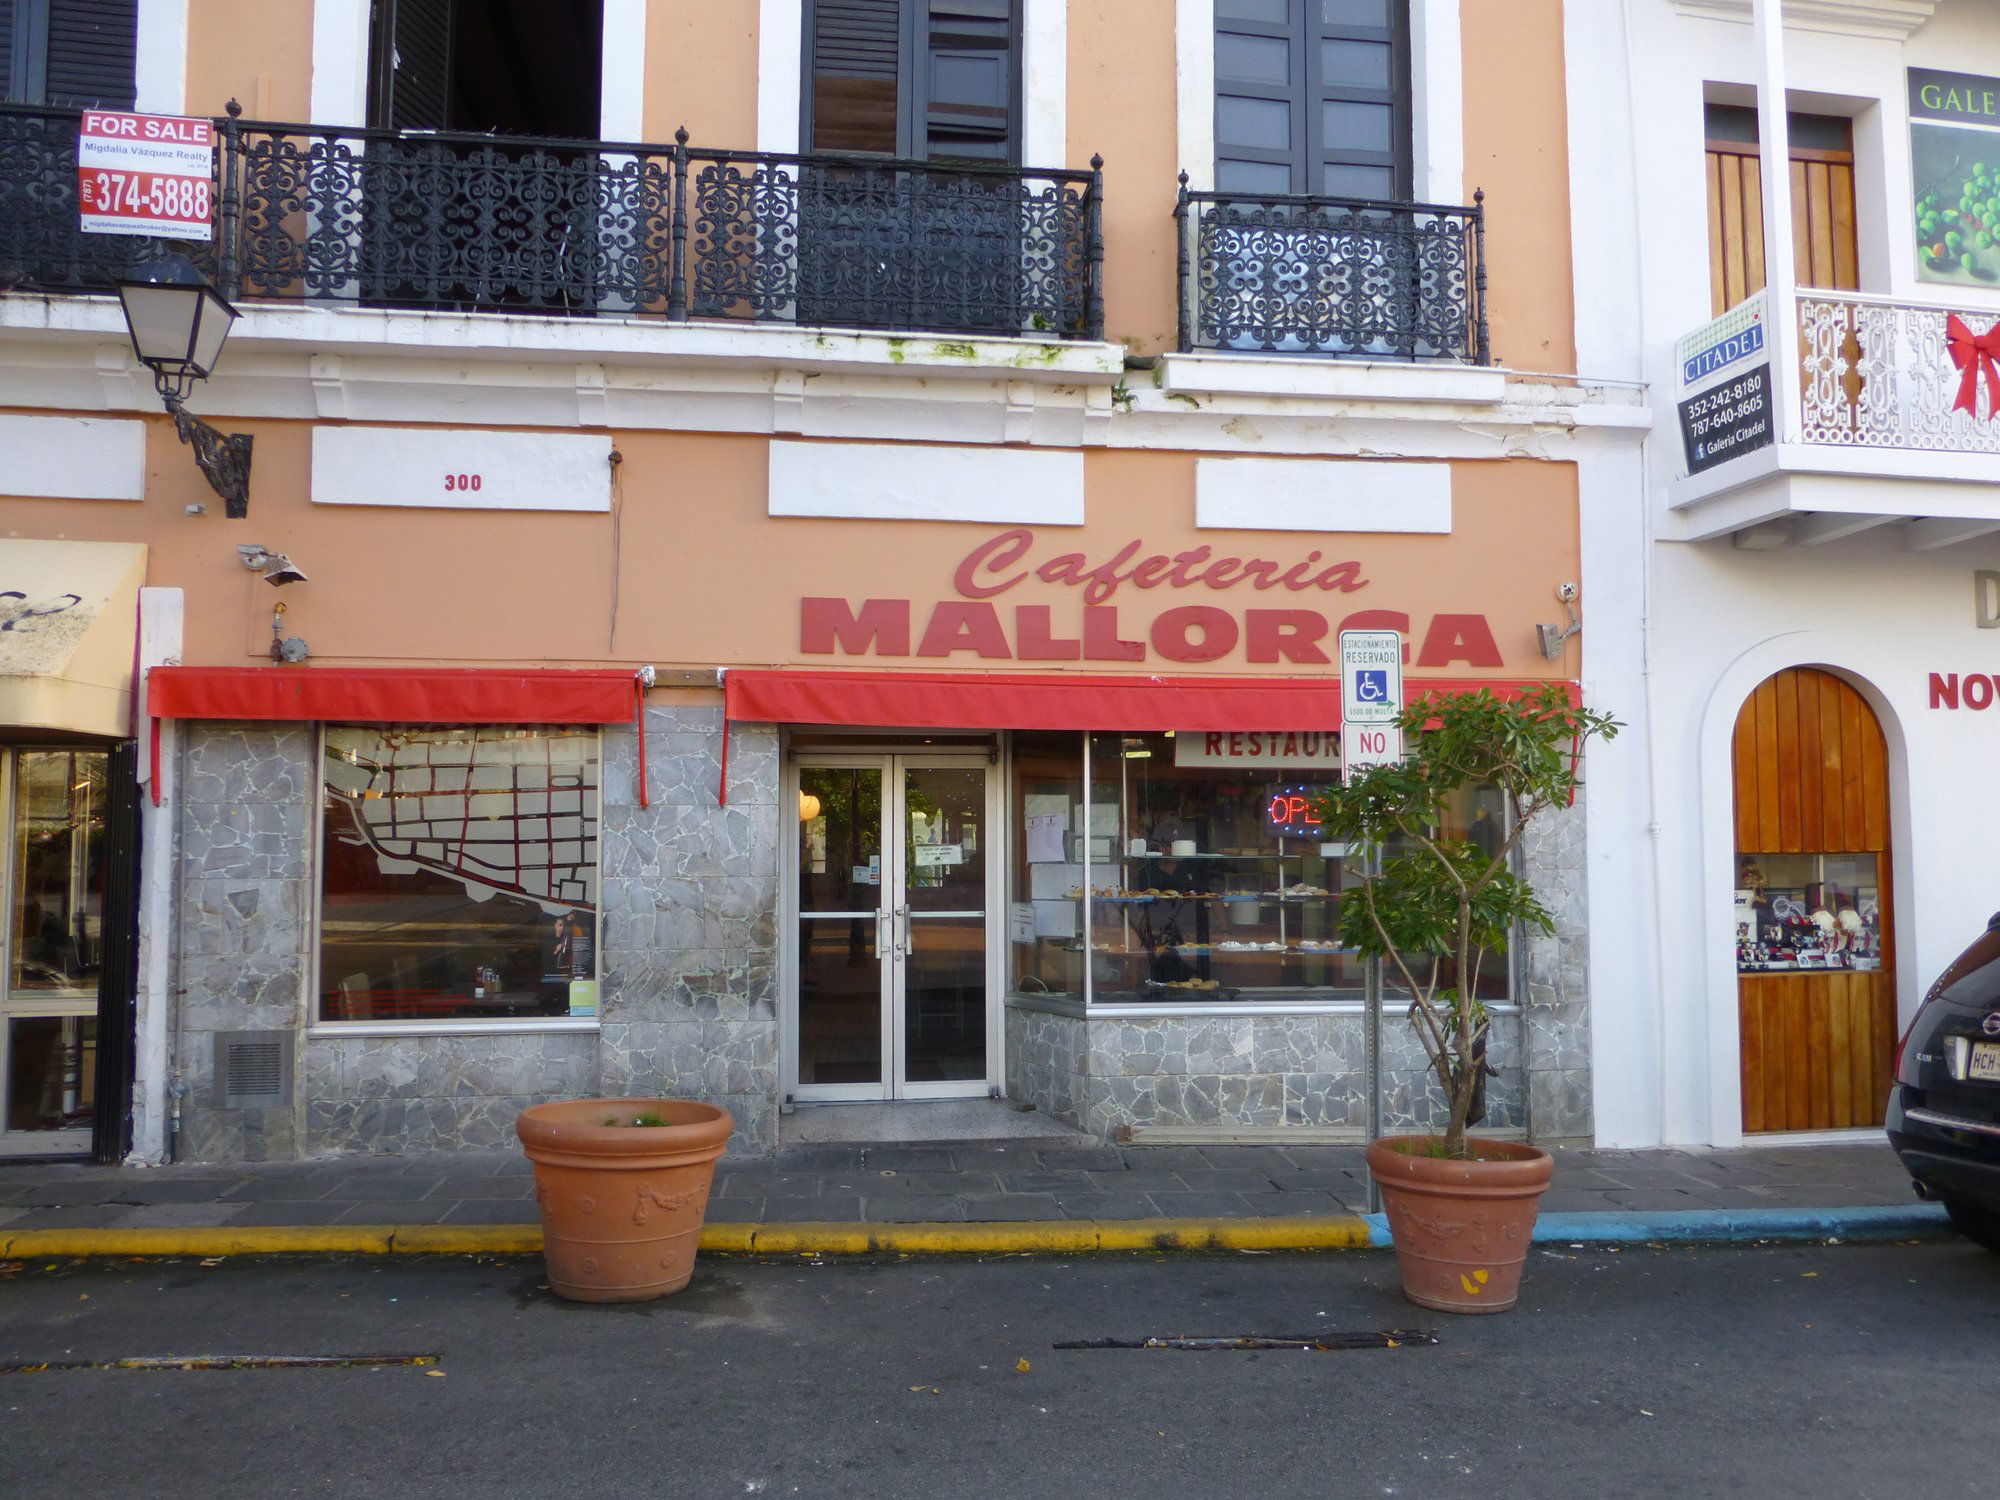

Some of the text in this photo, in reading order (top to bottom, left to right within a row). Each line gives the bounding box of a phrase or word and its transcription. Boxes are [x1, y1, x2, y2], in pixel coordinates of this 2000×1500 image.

[1920, 84, 1996, 116] GALE
[86, 116, 208, 142] FOR SALE
[84, 142, 208, 164] Migdalia Vázquez Realty
[83, 179, 93, 203] (787)
[96, 172, 209, 220] 374-5888
[1684, 329, 1762, 382] CITADEL
[1688, 375, 1762, 420] 352-242-8180
[1691, 394, 1763, 438] 787-640-8605
[1706, 434, 1735, 455] Galeria
[1735, 418, 1766, 443] Citadel
[445, 474, 482, 491] 300
[953, 528, 1371, 606] Cafeteria
[1343, 639, 1397, 650] ESTACIONAMIENTO
[1345, 651, 1397, 665] RESERVADO
[1928, 672, 2000, 711] NO
[1374, 707, 1395, 716] MULTA
[1359, 732, 1387, 754] NO
